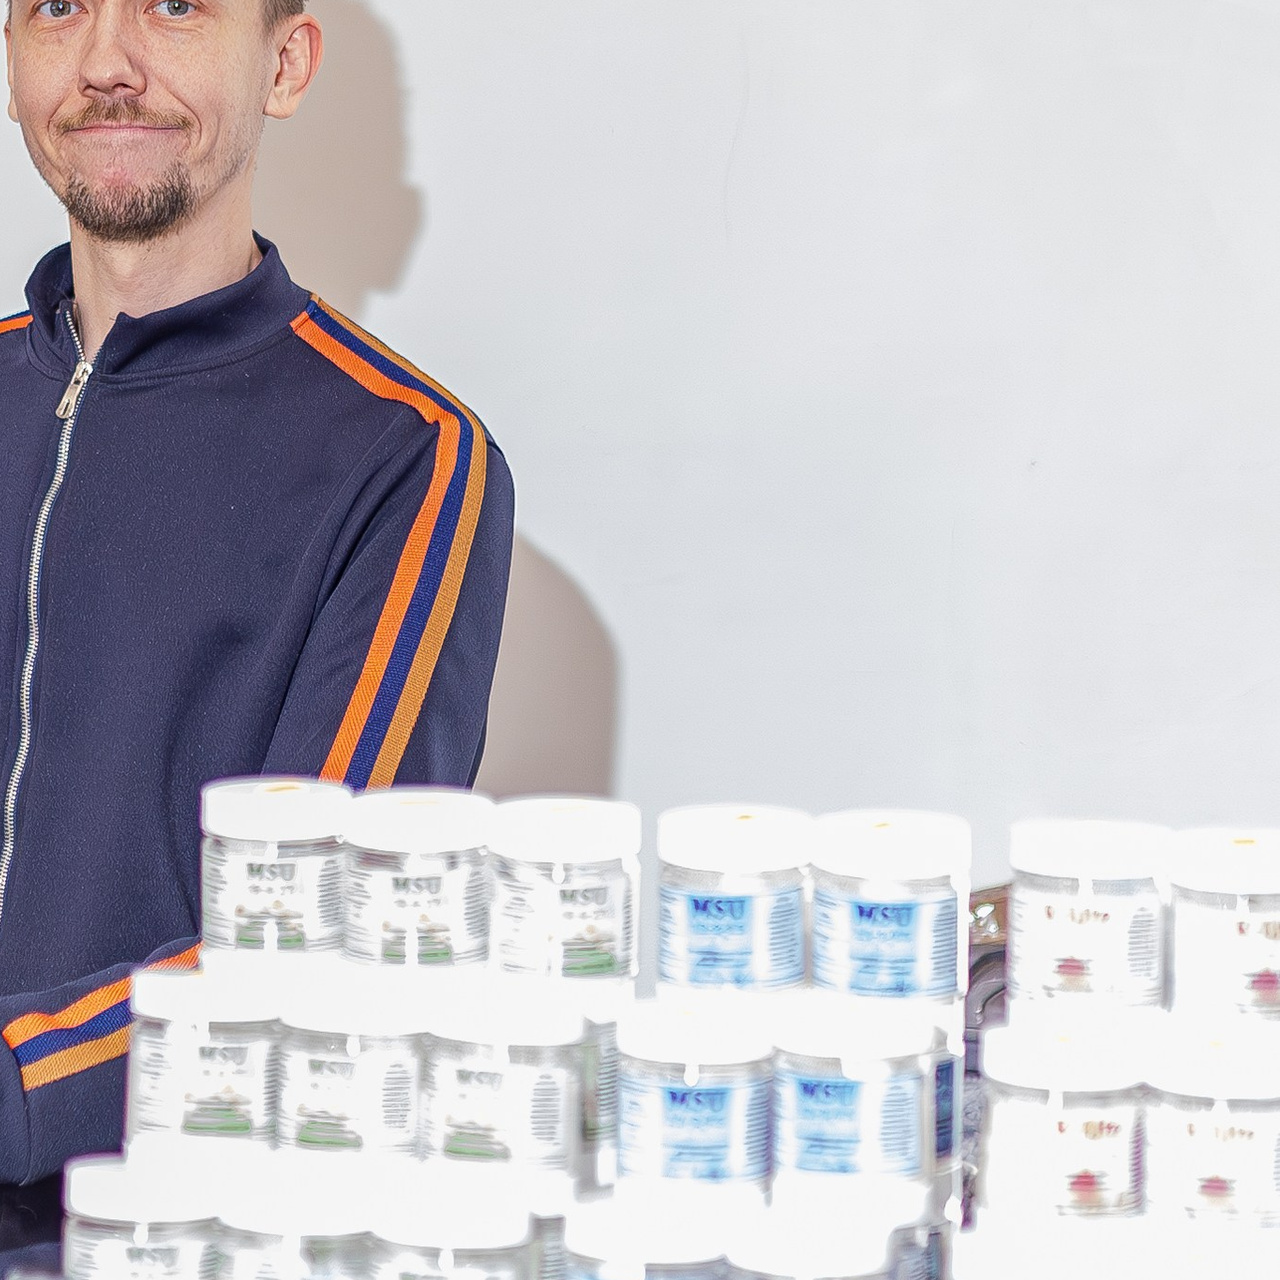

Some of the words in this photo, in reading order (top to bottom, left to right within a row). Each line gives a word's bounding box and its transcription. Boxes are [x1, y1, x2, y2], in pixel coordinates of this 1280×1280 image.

[246, 862, 297, 882] MSU
[391, 876, 443, 895] MSU
[692, 898, 746, 919] MSU
[857, 904, 912, 926] MSU
